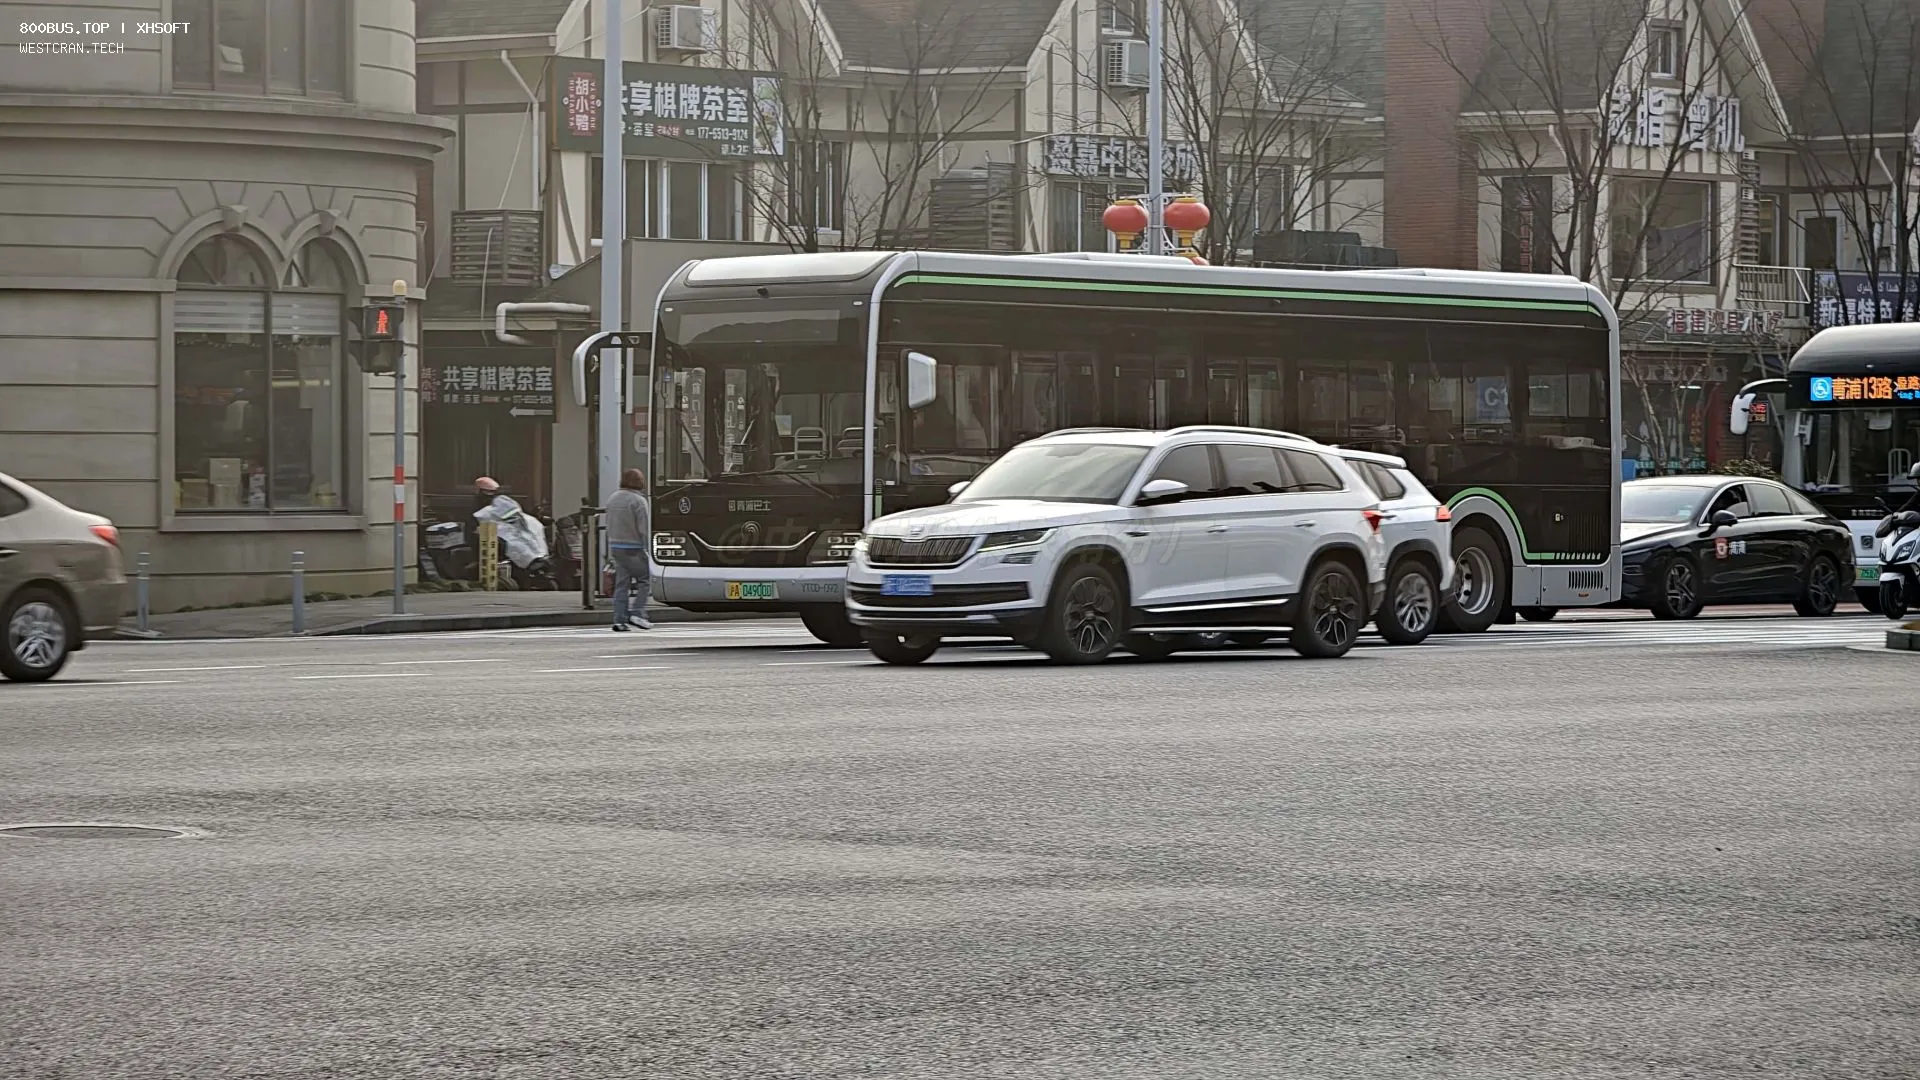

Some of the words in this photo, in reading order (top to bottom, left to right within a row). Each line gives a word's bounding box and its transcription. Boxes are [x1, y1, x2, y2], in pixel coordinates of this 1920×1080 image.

[575, 77, 590, 131] 胡小鸭
[443, 365, 553, 391] 共享棋牌茶室
[1832, 377, 1893, 400] 青浦13路
